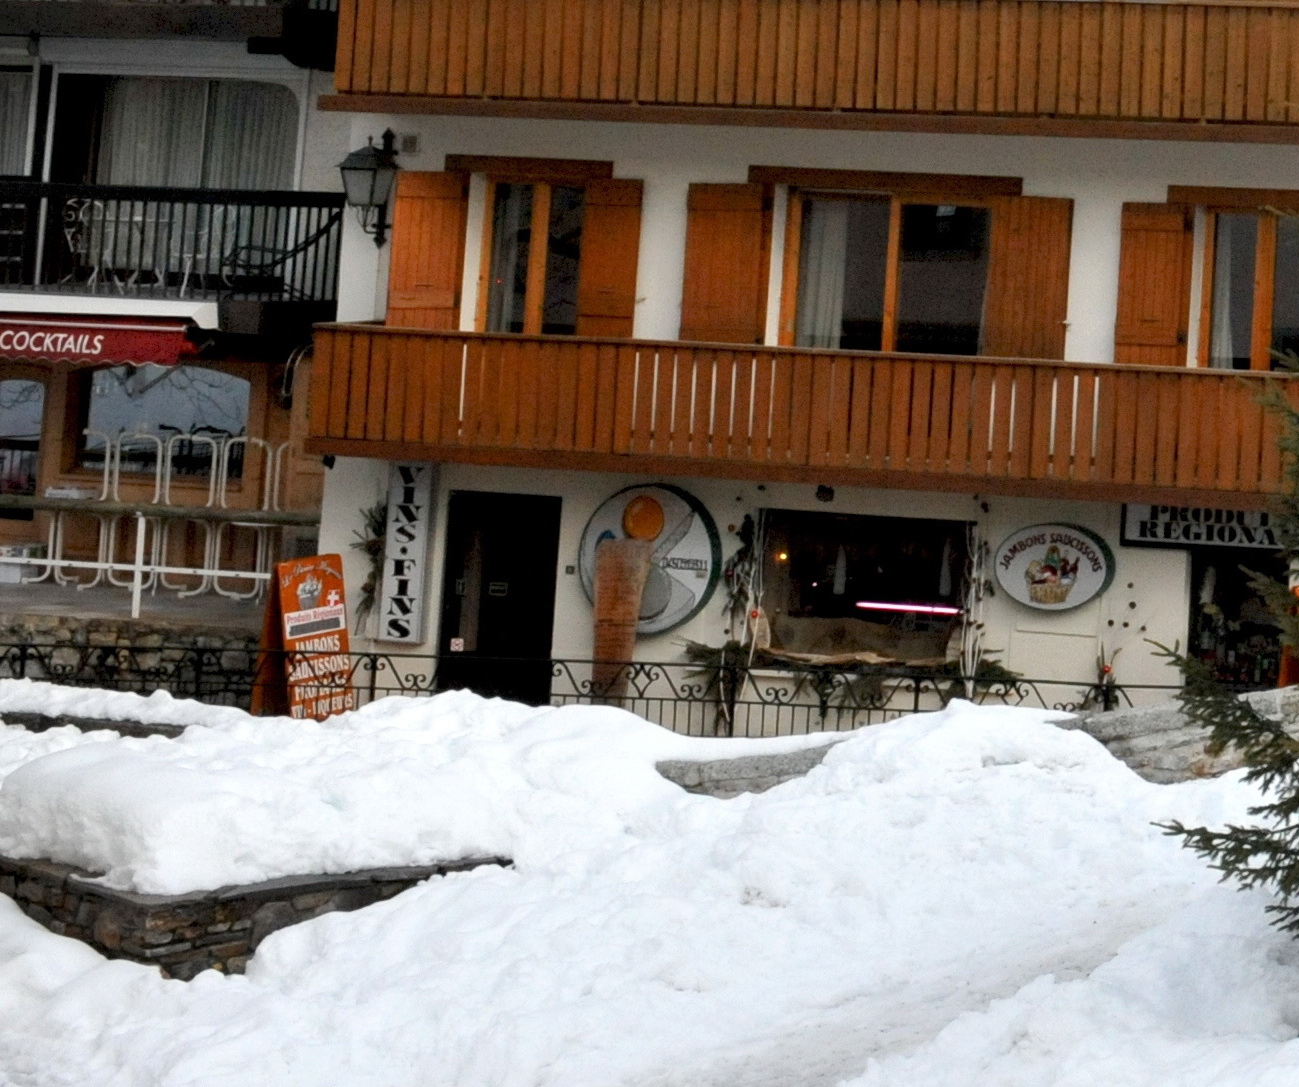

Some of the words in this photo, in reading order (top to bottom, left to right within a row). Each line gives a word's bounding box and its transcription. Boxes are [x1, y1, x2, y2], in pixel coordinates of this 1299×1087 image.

[0, 330, 105, 355] COCKTAILS
[1150, 504, 1270, 527] PRODUI
[1139, 520, 1279, 546] REGIONA
[999, 532, 1047, 571] JAMBONS
[1049, 532, 1103, 573] SAUCISSONS
